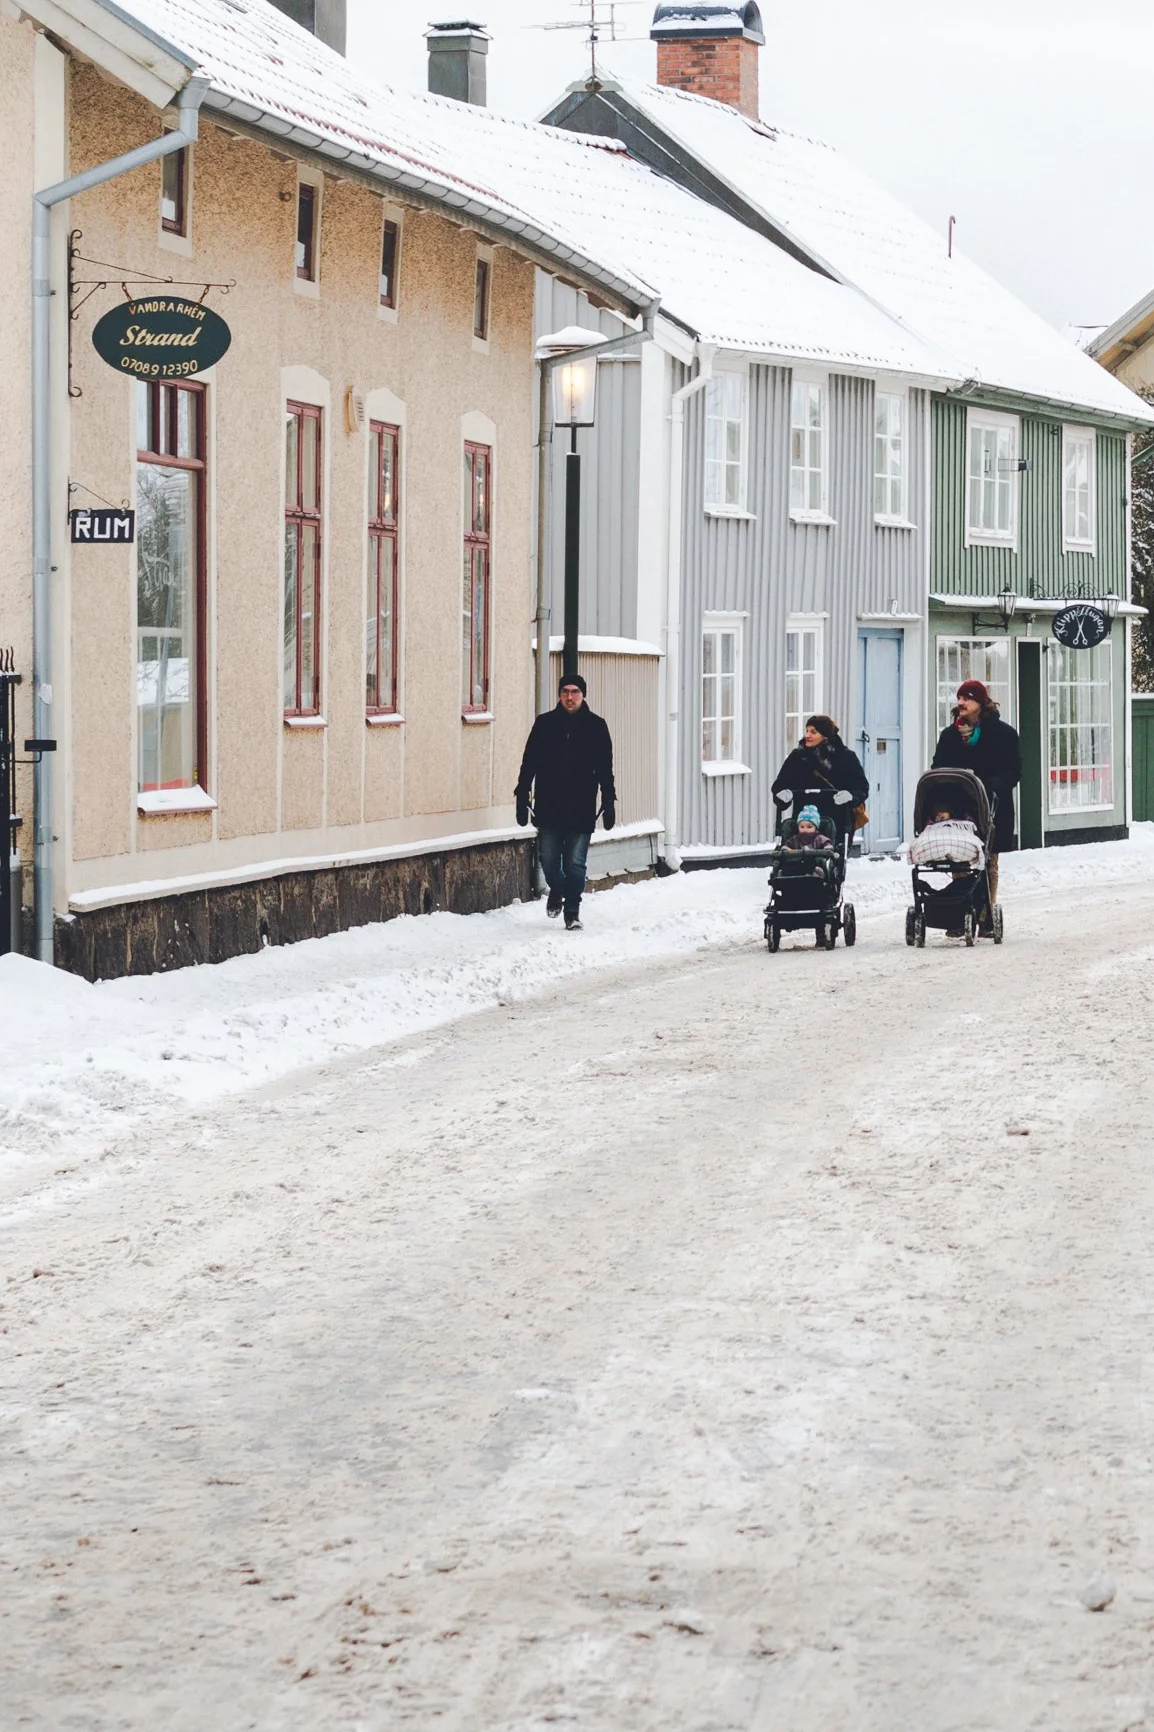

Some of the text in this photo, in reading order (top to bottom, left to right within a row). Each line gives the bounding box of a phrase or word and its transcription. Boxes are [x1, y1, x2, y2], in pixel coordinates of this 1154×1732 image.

[129, 301, 206, 321] VANDRARHEM
[120, 325, 202, 346] Strand
[75, 517, 130, 539] RUM
